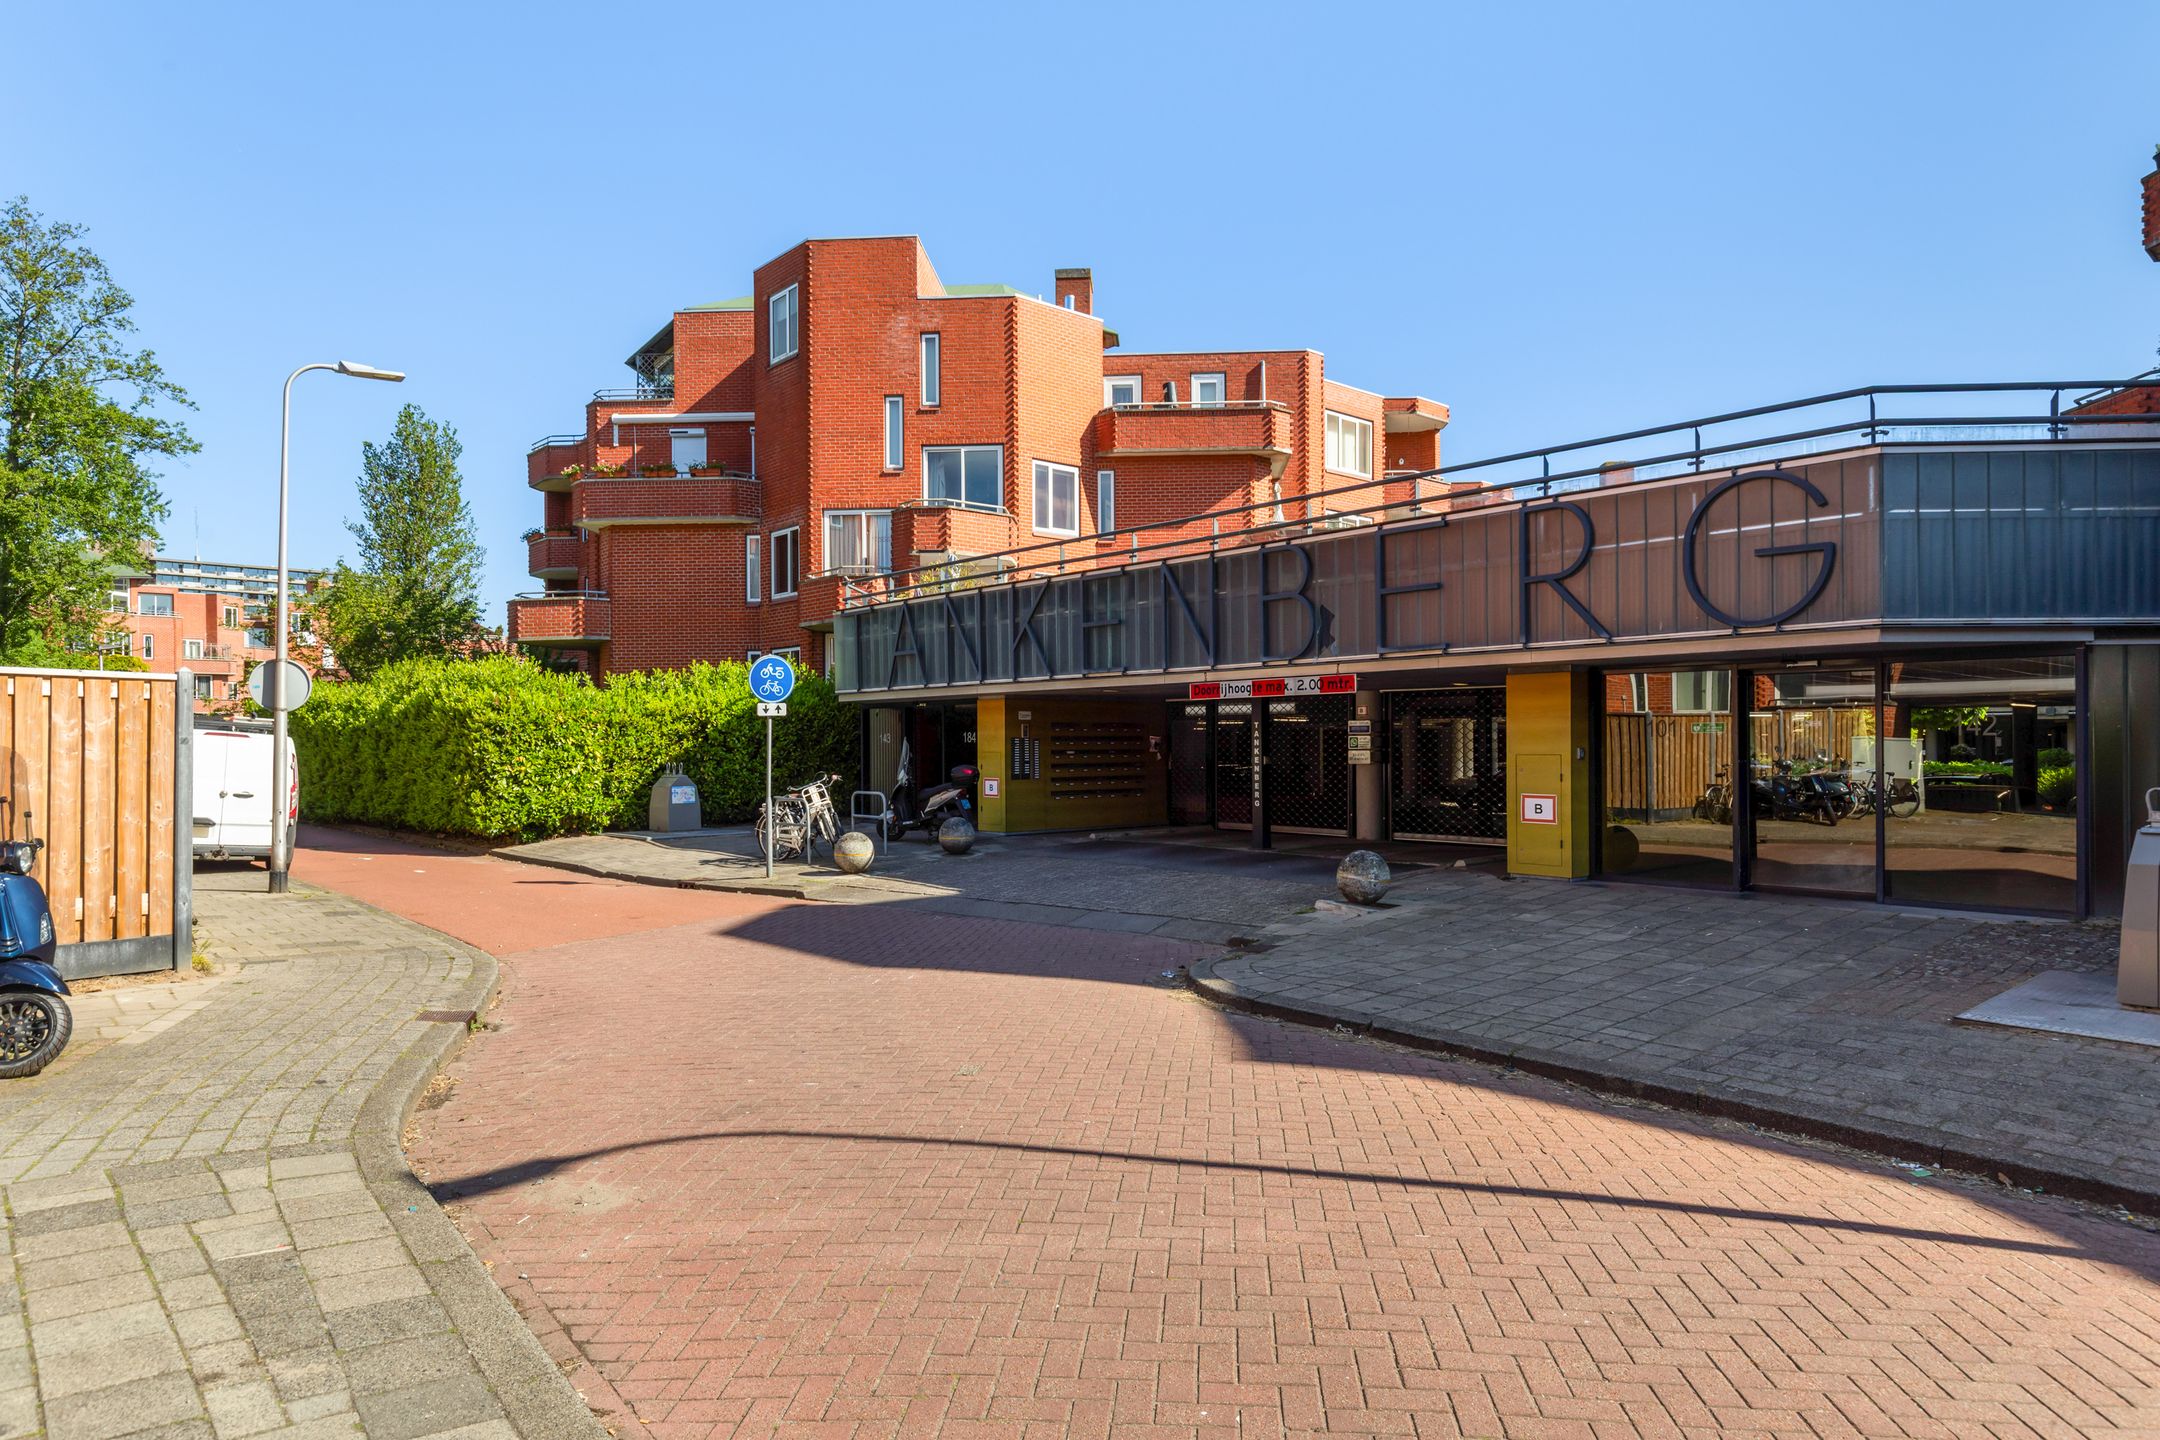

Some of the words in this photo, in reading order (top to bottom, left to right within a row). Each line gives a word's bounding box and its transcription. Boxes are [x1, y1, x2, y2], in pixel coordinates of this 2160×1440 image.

[840, 469, 1836, 694] TANKENBERG
[1193, 682, 1262, 698] Doorrijhoogte
[1266, 682, 1293, 696] max.
[1297, 678, 1323, 691] 2.00
[1327, 677, 1353, 690] mtr.
[1647, 719, 1676, 737] 101
[1953, 714, 1997, 736] 142
[963, 732, 976, 743] 184
[1534, 803, 1543, 814] B
